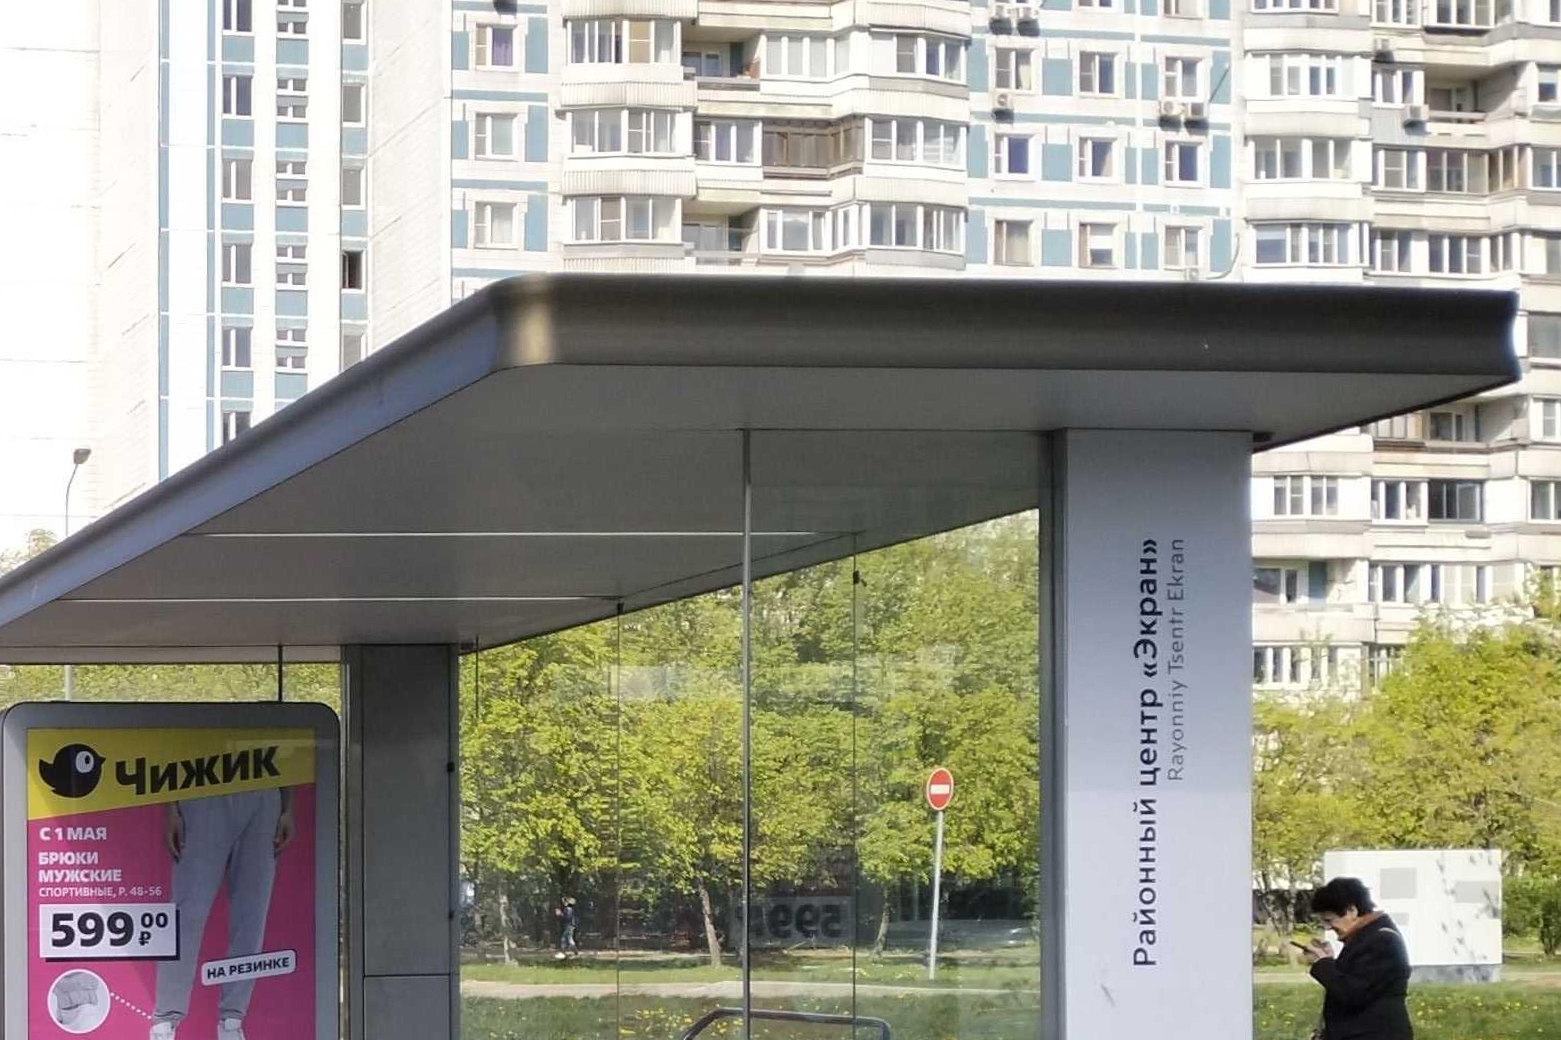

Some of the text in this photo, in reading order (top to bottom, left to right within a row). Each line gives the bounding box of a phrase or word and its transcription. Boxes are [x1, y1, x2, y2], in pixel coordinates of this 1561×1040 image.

[1166, 538, 1188, 781] Rayonniy Tsentr Ekran
[1132, 538, 1164, 966] Районный центр «Экран»
[39, 826, 108, 841] С 1 МАЯ
[38, 851, 99, 866] БРЮКИ
[38, 868, 123, 883] МУЖСКИЕ
[38, 885, 163, 898] СПОРТИВНЫЕ, Р. 48-56
[51, 911, 169, 948] 599 00
[206, 957, 291, 980] НА РЕЗИНКЕ
